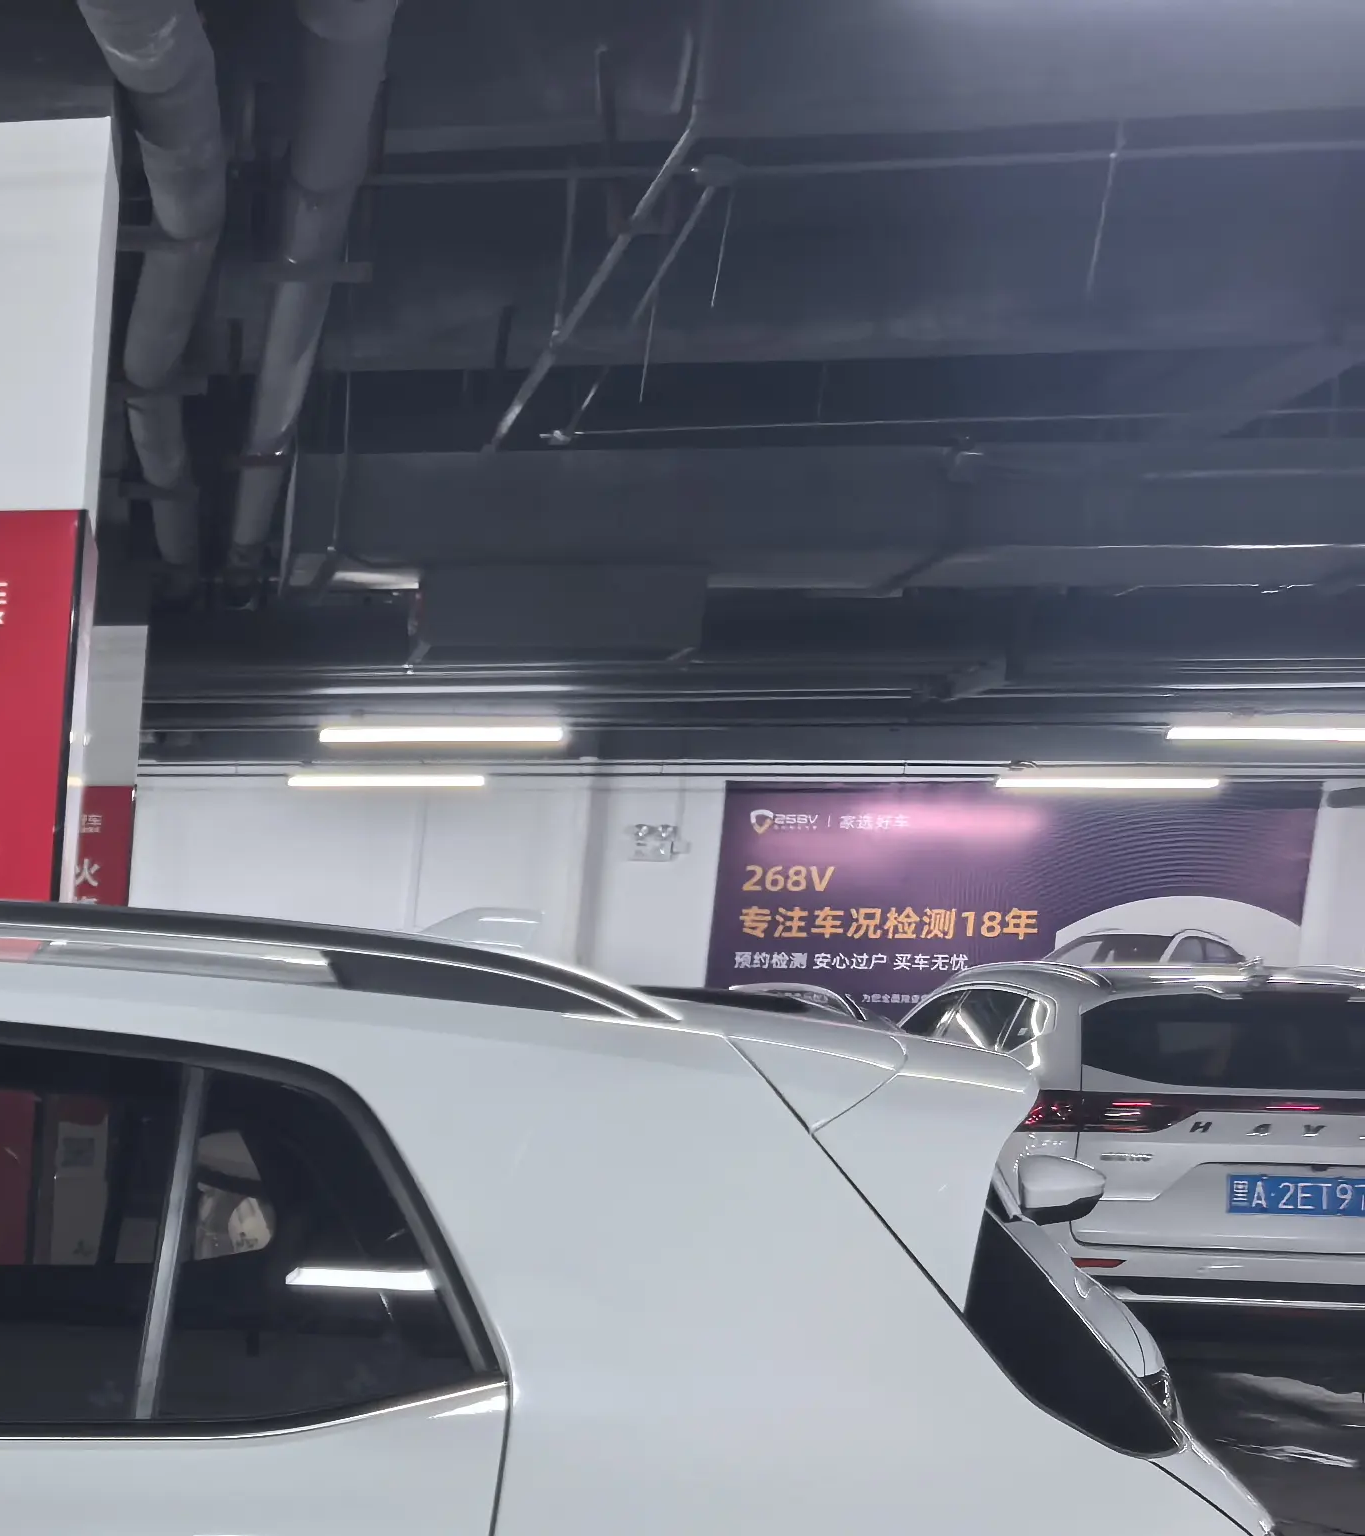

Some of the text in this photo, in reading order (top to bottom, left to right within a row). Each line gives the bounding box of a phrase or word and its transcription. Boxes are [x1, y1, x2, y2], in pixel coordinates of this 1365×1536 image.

[742, 865, 836, 892] 268V
[739, 905, 1039, 940] 专注车况检测18年
[734, 951, 970, 972] 预约检测 安心过户 买车无忧
[1189, 1121, 1365, 1139] HAV
